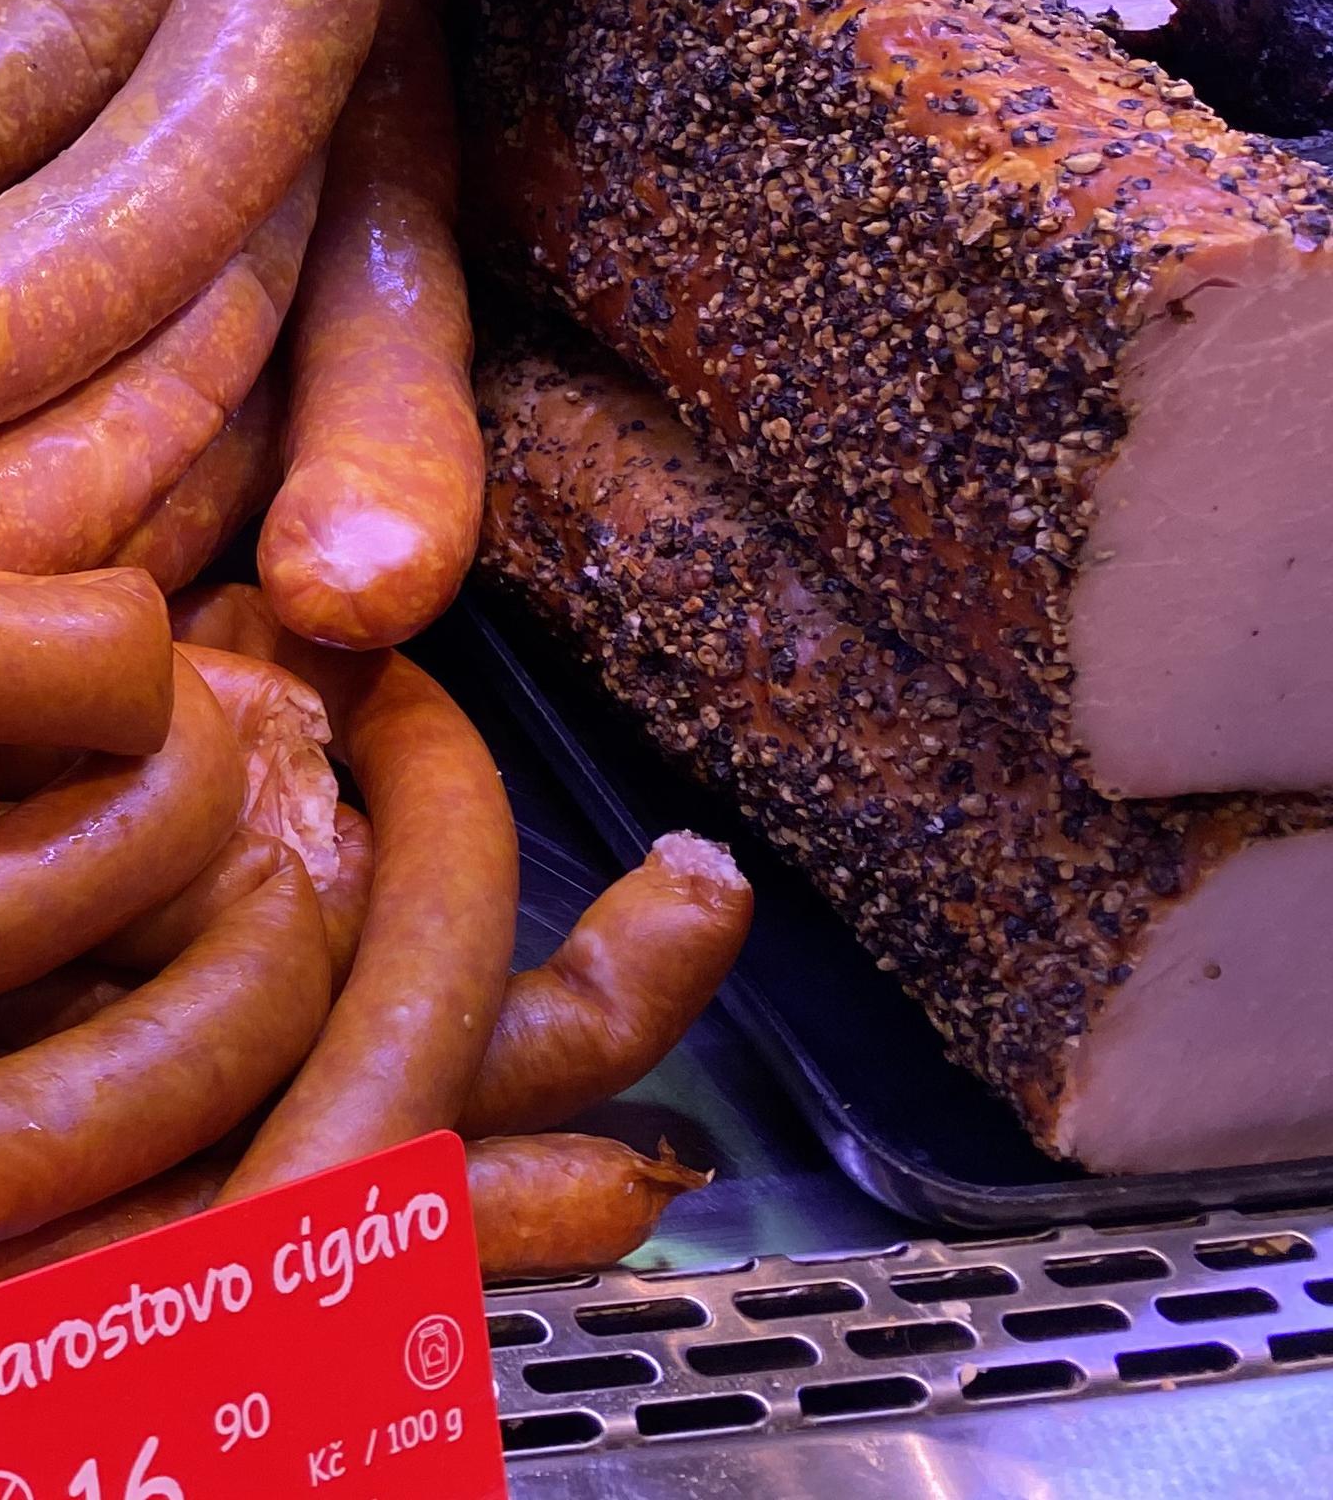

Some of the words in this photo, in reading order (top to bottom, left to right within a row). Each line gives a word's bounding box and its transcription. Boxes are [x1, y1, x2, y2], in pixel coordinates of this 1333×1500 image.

[272, 1185, 449, 1308] cigáro
[214, 1392, 271, 1452] 90
[309, 1442, 346, 1488] Kč
[387, 1409, 438, 1456] 100
[444, 1405, 464, 1443] g
